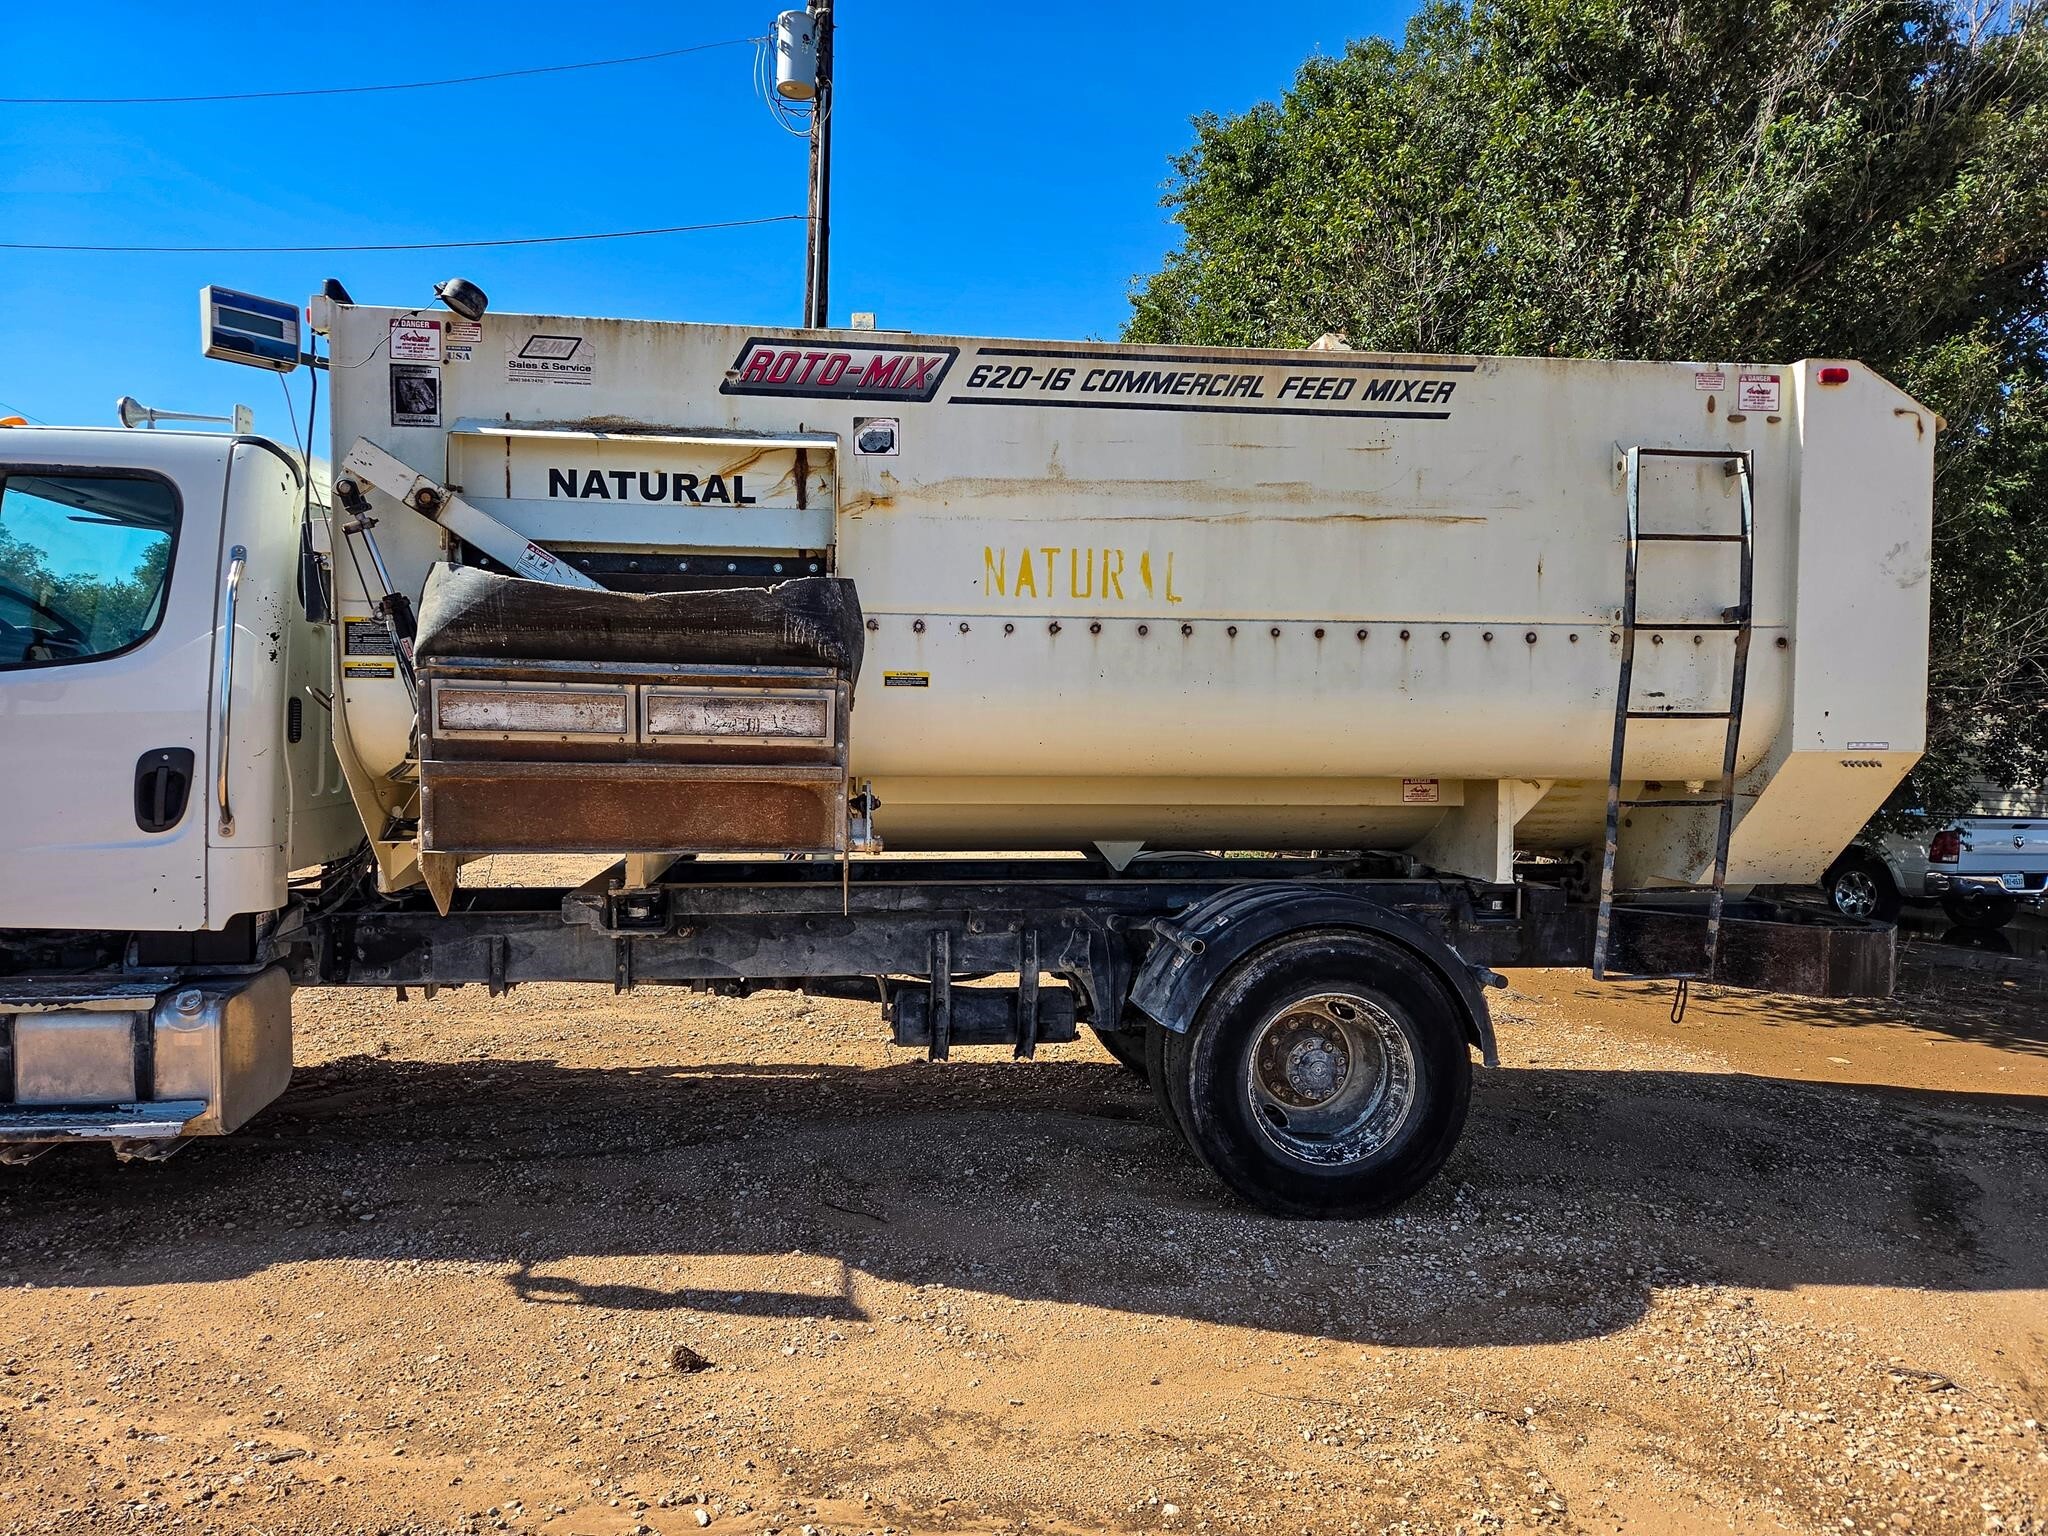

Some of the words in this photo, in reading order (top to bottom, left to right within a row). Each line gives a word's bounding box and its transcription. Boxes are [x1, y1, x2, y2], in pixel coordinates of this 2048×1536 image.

[400, 320, 430, 328] DANGER
[446, 352, 471, 361] USA
[508, 360, 538, 369] Sales
[541, 362, 550, 370] &
[552, 362, 592, 372] Service
[966, 364, 1076, 391] 620-16
[1080, 368, 1265, 399] COMMERCIAL
[1277, 376, 1358, 401] FEED
[1360, 378, 1457, 404] MIXER
[549, 468, 757, 504] NATURAL
